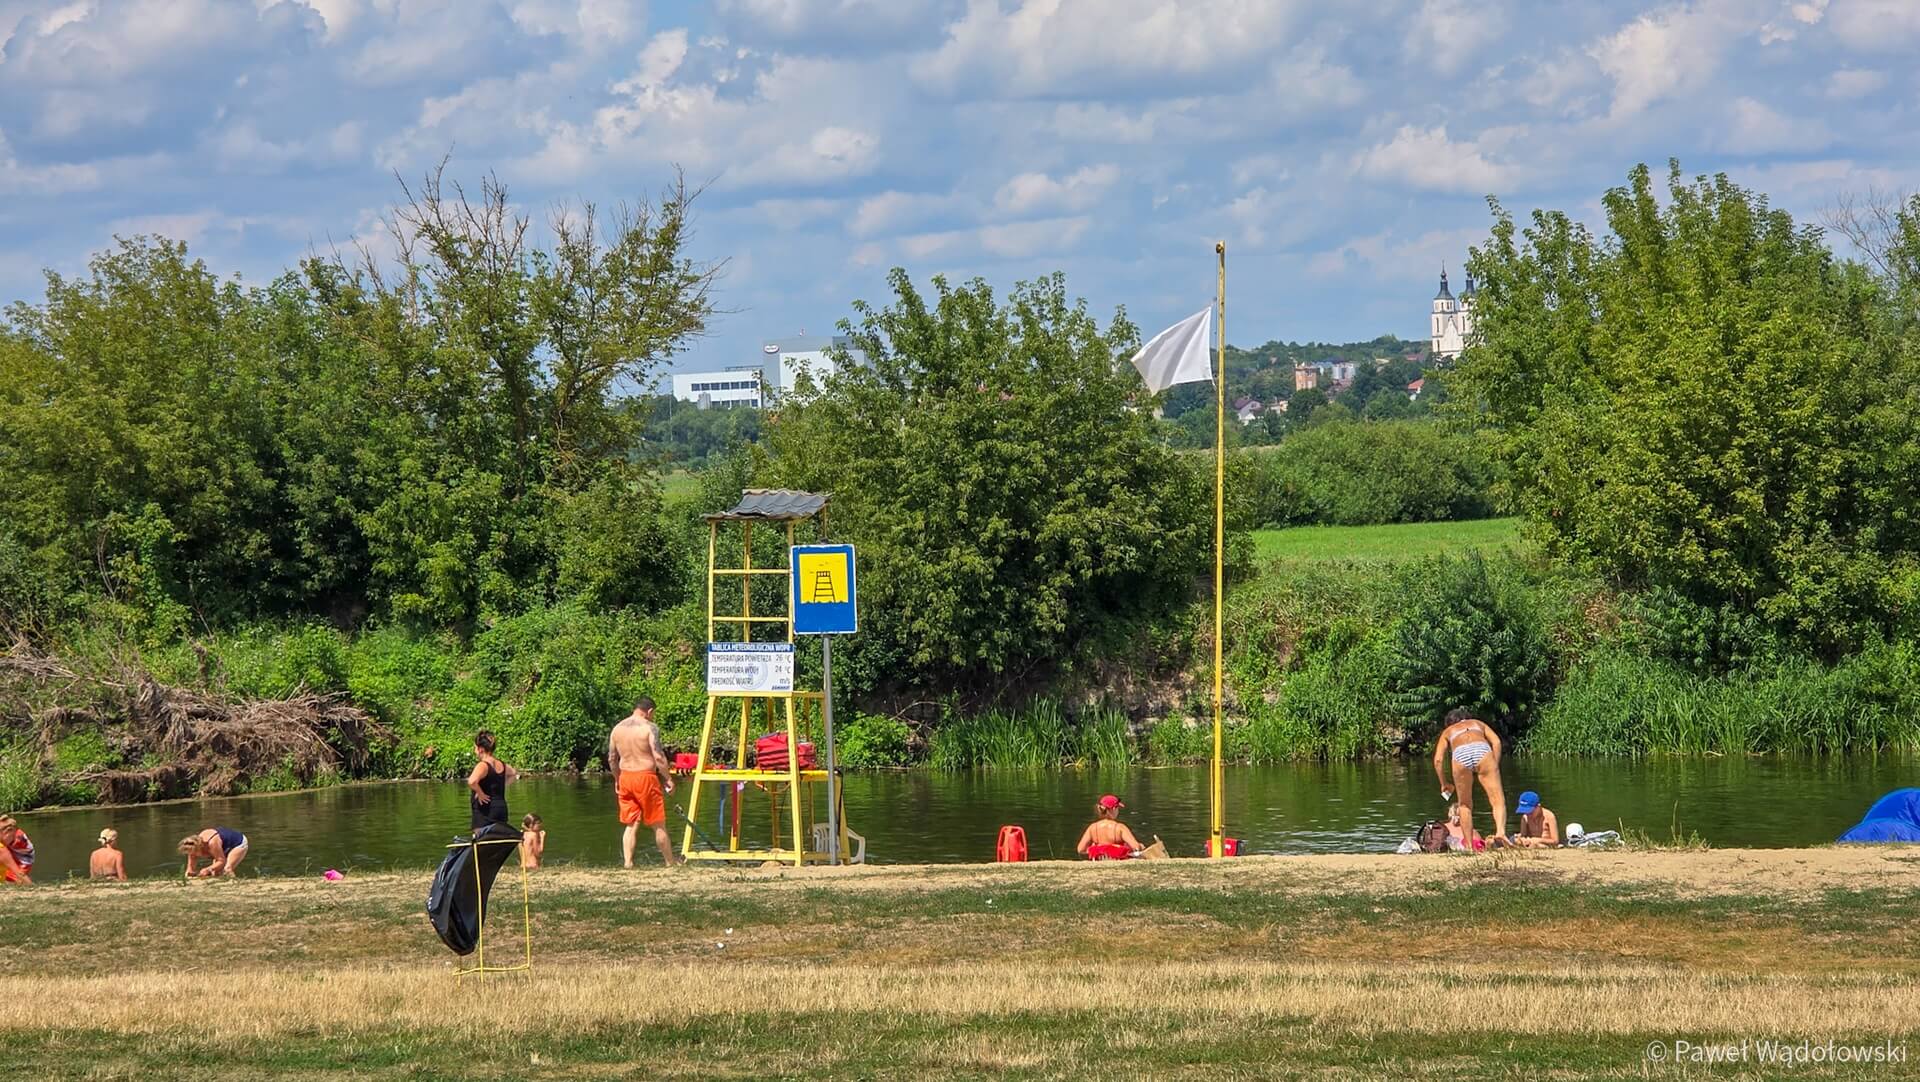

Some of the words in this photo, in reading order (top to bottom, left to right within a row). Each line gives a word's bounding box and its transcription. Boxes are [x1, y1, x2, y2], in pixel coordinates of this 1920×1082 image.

[711, 654, 744, 663] TEMPERATURA
[745, 654, 772, 662] POWIETRZA
[711, 666, 744, 674] TEMPERATURA
